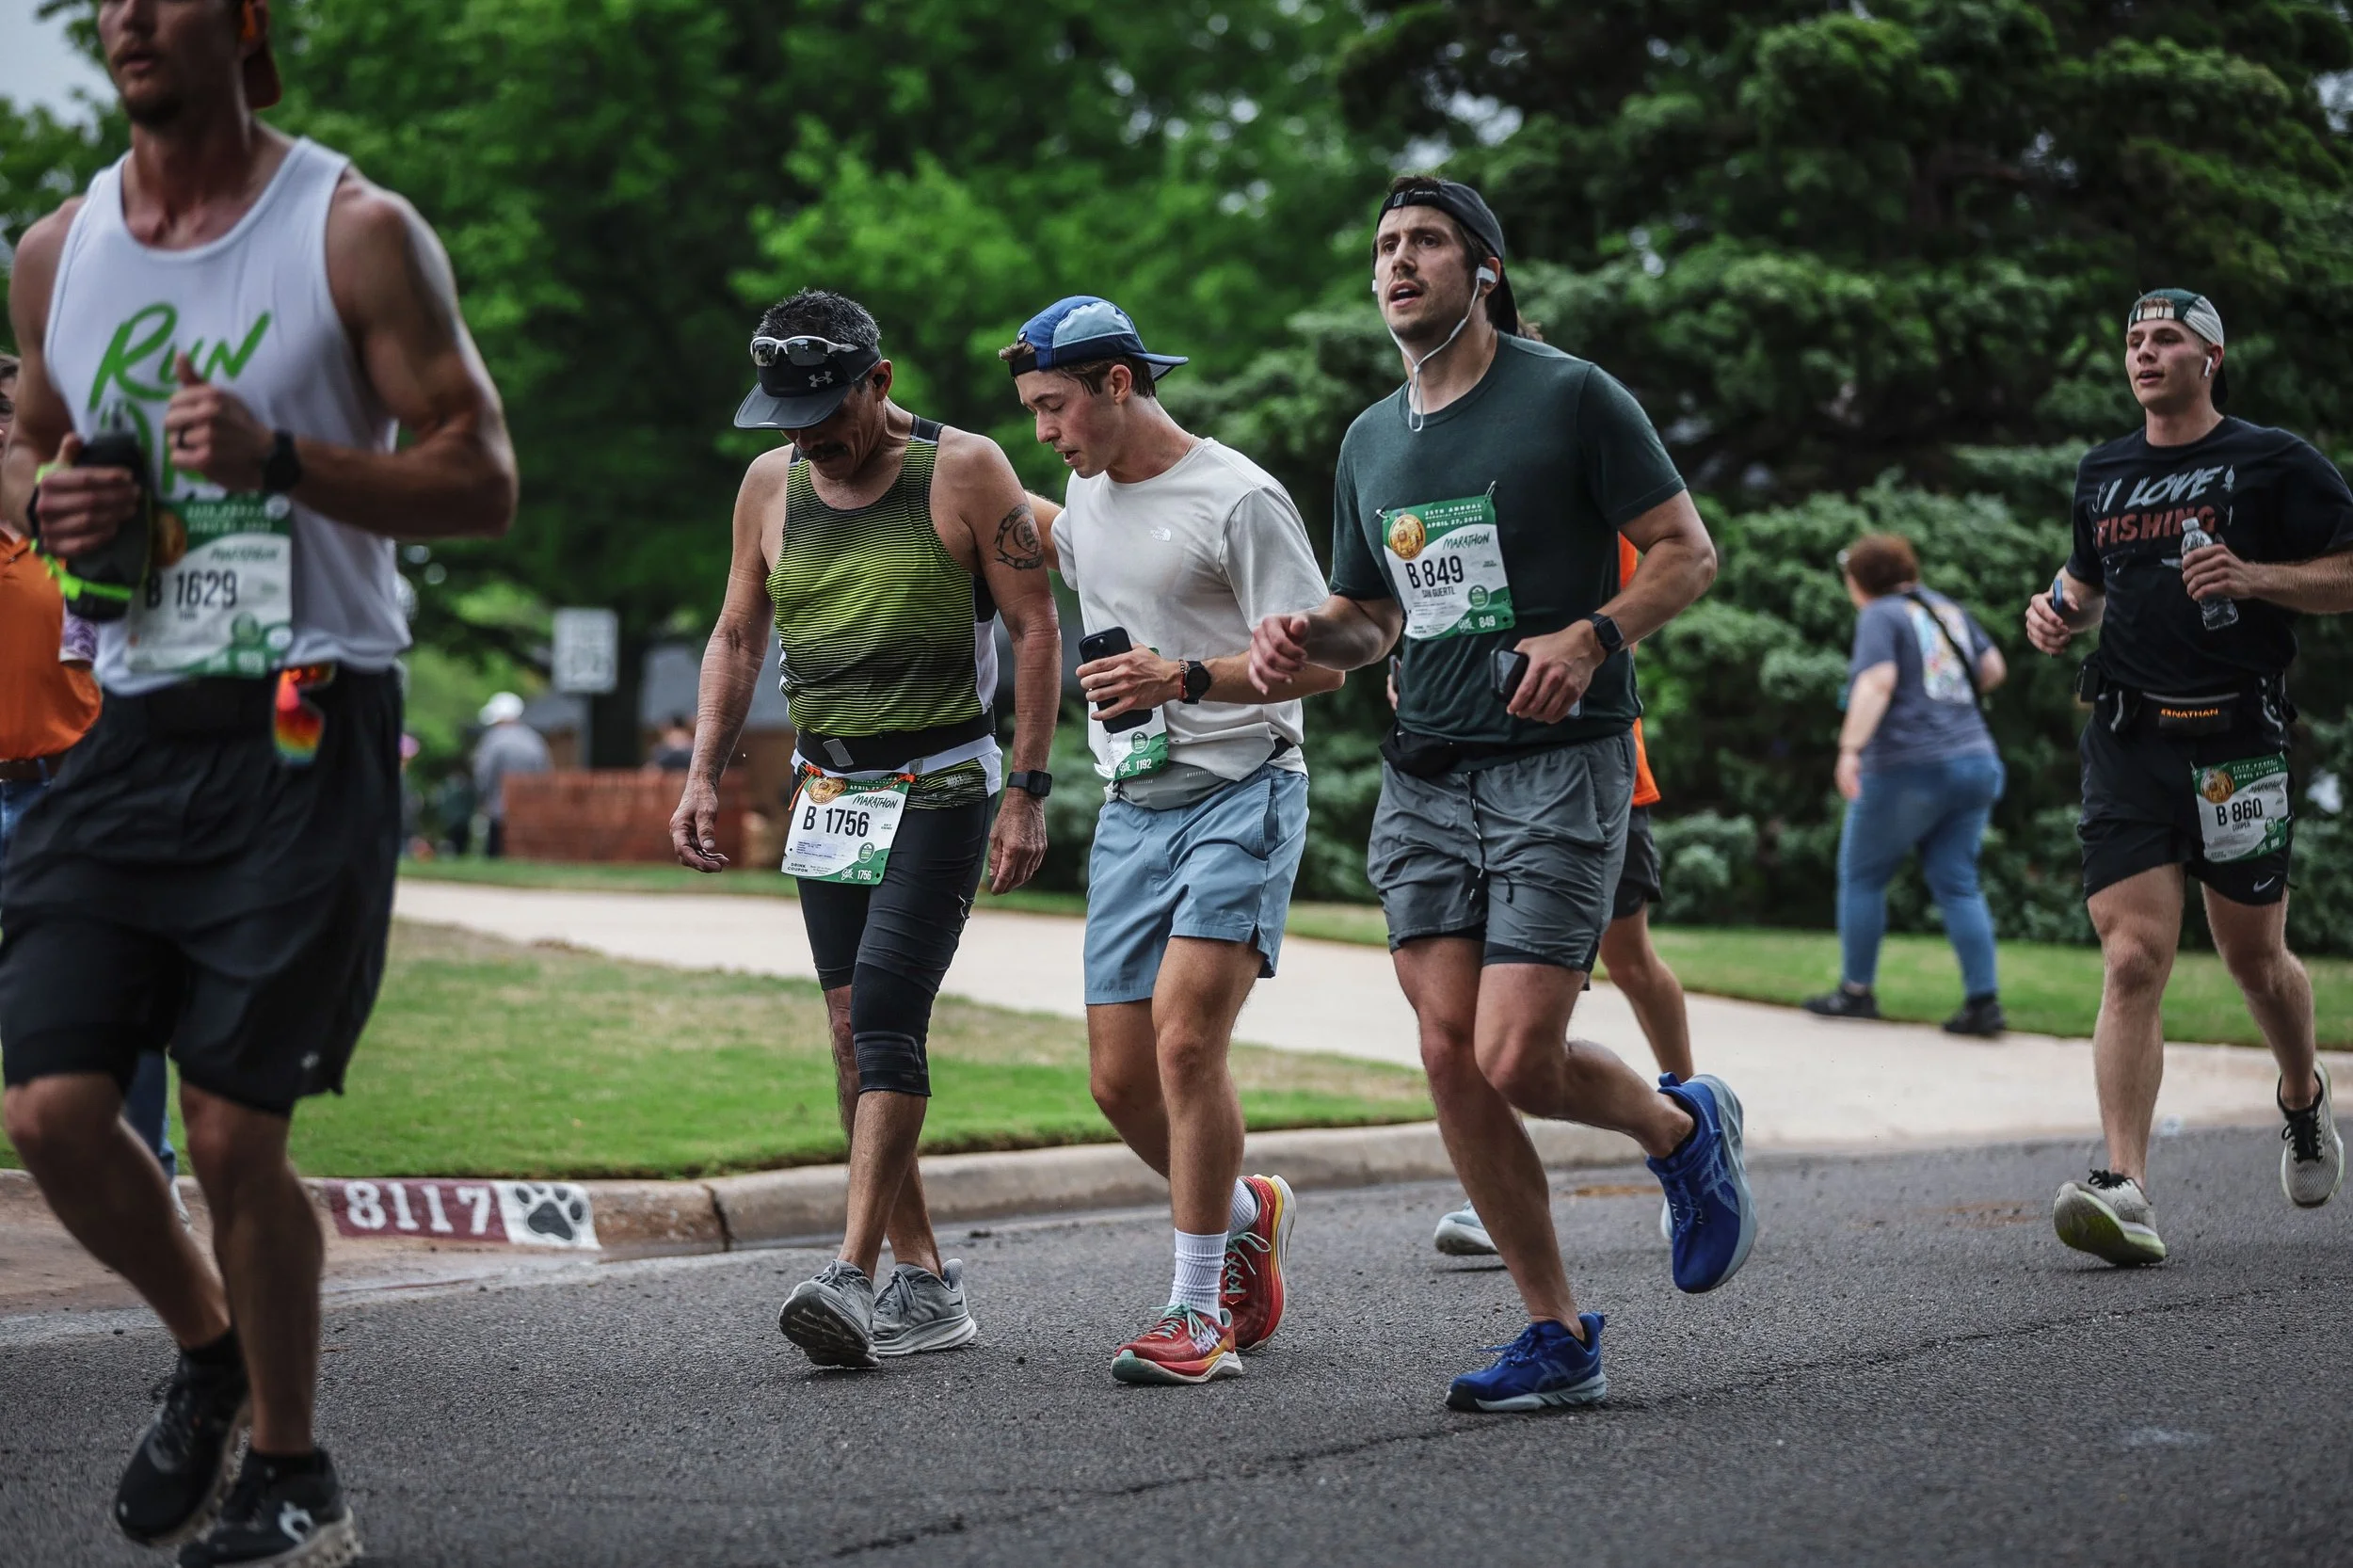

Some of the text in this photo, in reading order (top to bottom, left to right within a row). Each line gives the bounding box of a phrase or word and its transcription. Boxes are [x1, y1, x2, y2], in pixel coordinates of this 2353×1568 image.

[2102, 465, 2224, 512] I LOVE
[1426, 520, 1449, 529] APRIL
[2096, 505, 2216, 548] FISHING
[1443, 532, 1491, 550] MARATHON
[1405, 555, 1465, 589] B 849
[146, 568, 237, 610] B 1629
[1479, 615, 1497, 629] 849
[2172, 707, 2219, 718] NATHAN
[1135, 758, 1152, 771] 1192
[852, 794, 899, 809] MARATHON
[2215, 798, 2263, 826] B 860
[803, 806, 870, 838] B 1756
[857, 869, 872, 881] 1756
[344, 1180, 491, 1235] 8117
